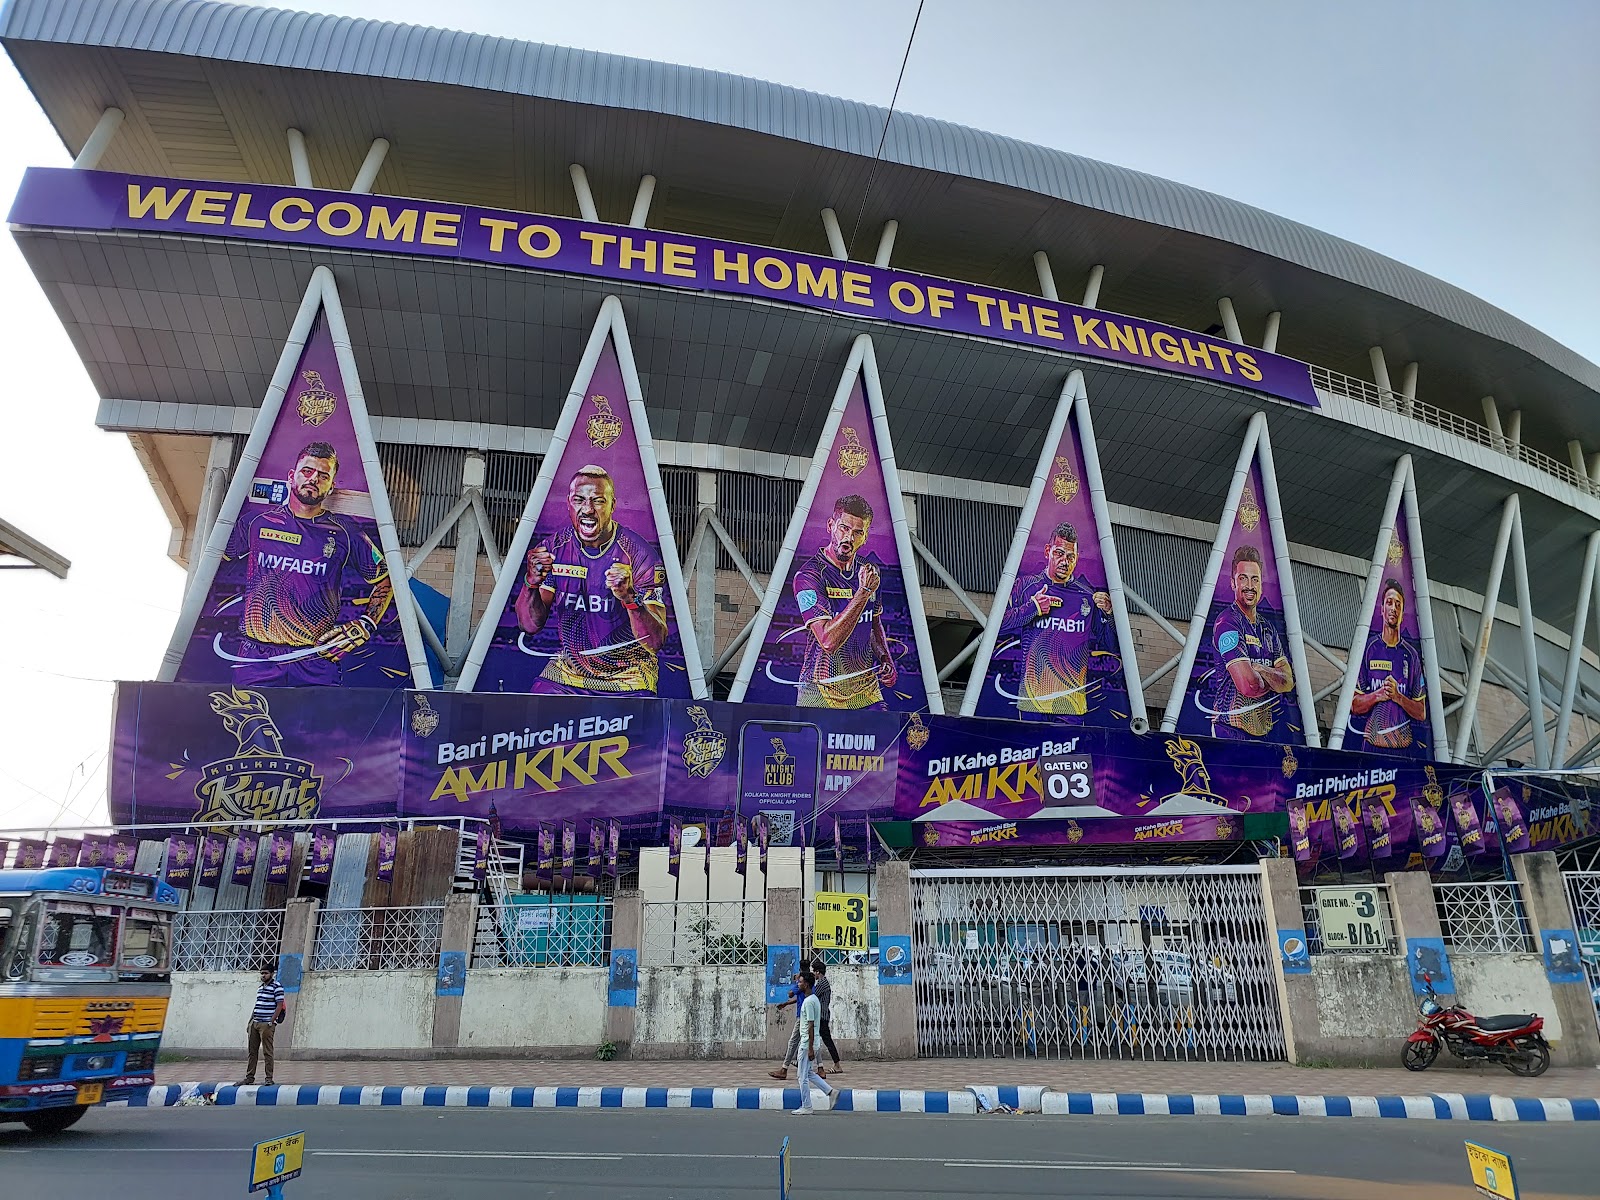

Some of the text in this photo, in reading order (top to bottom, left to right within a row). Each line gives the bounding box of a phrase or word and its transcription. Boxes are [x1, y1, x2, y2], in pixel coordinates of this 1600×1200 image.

[126, 183, 1265, 383] WELCOME TO THE HOME OF THE KNIGHTS
[437, 714, 634, 765] Bari Phirchi Ebar
[686, 737, 725, 754] Knight
[827, 733, 876, 751] EKDUM
[684, 747, 724, 766] Riders
[826, 753, 885, 772] FATAFATI
[928, 736, 1080, 777] Dil Kahe Baar Baar
[1044, 760, 1089, 771] GATE NO
[210, 760, 306, 776] KOLKATA
[429, 735, 633, 803] AMI KKR
[765, 763, 795, 773] KNIGHT
[766, 773, 793, 785] CLUB
[824, 774, 853, 791] APP
[1047, 772, 1091, 799] 03
[1296, 767, 1398, 799] Bari Phirchi Ebar
[201, 774, 317, 817] Knight
[919, 772, 984, 808] AMI
[969, 827, 1019, 845] AMI KKR
[1153, 823, 1185, 838] KKR
[817, 902, 831, 911] GATE
[846, 898, 864, 923] 3
[1322, 898, 1339, 908] GATE
[1355, 891, 1376, 918] 3
